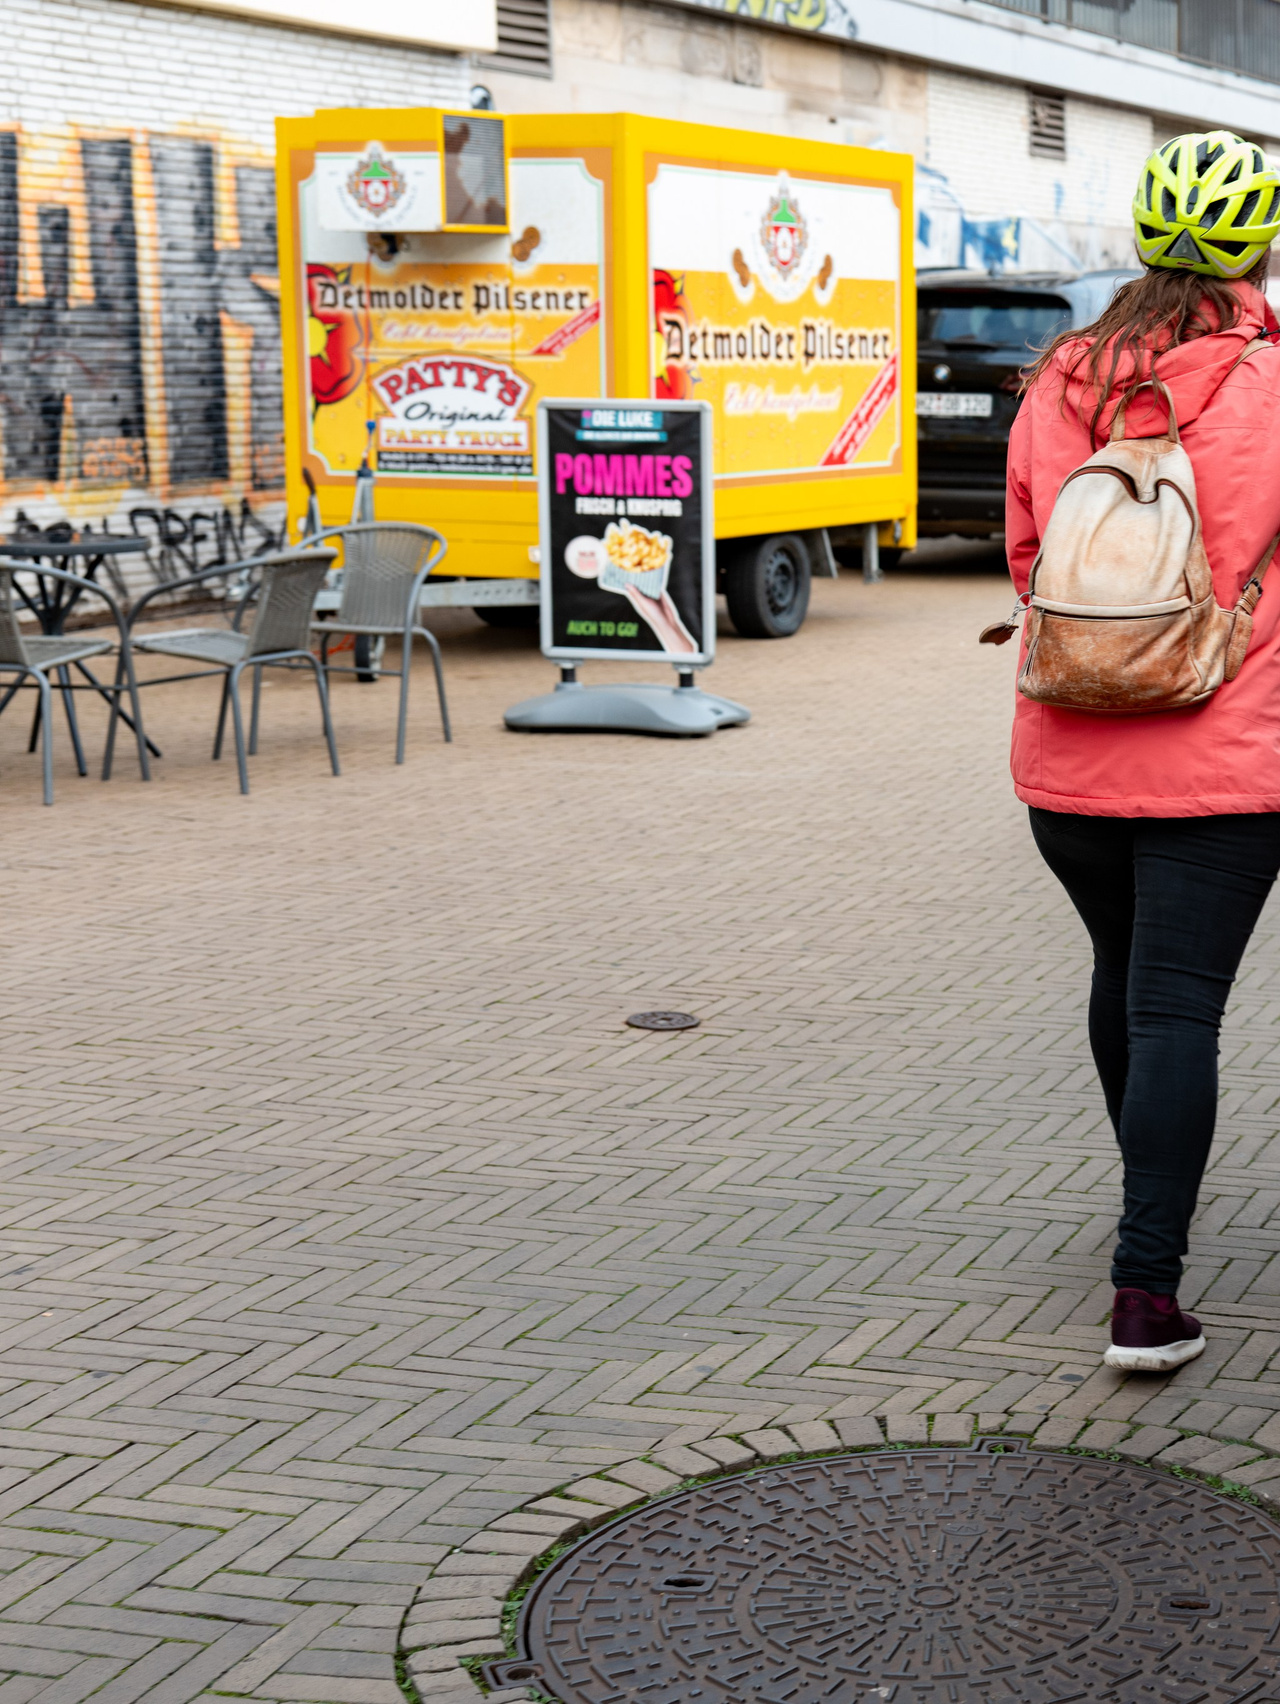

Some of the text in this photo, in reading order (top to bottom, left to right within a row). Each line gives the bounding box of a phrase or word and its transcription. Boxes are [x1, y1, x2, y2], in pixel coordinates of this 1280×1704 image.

[318, 282, 589, 314] Detmolder Pilsener
[664, 319, 890, 366] Detmolder Pilsener
[379, 361, 523, 407] PATTY'S
[404, 402, 507, 428] Original
[592, 410, 654, 428] DIE LUKE
[384, 429, 523, 447] PARTY TRUCK
[555, 453, 694, 498] POMMES
[566, 620, 598, 635] AUCH
[599, 621, 615, 636] TO
